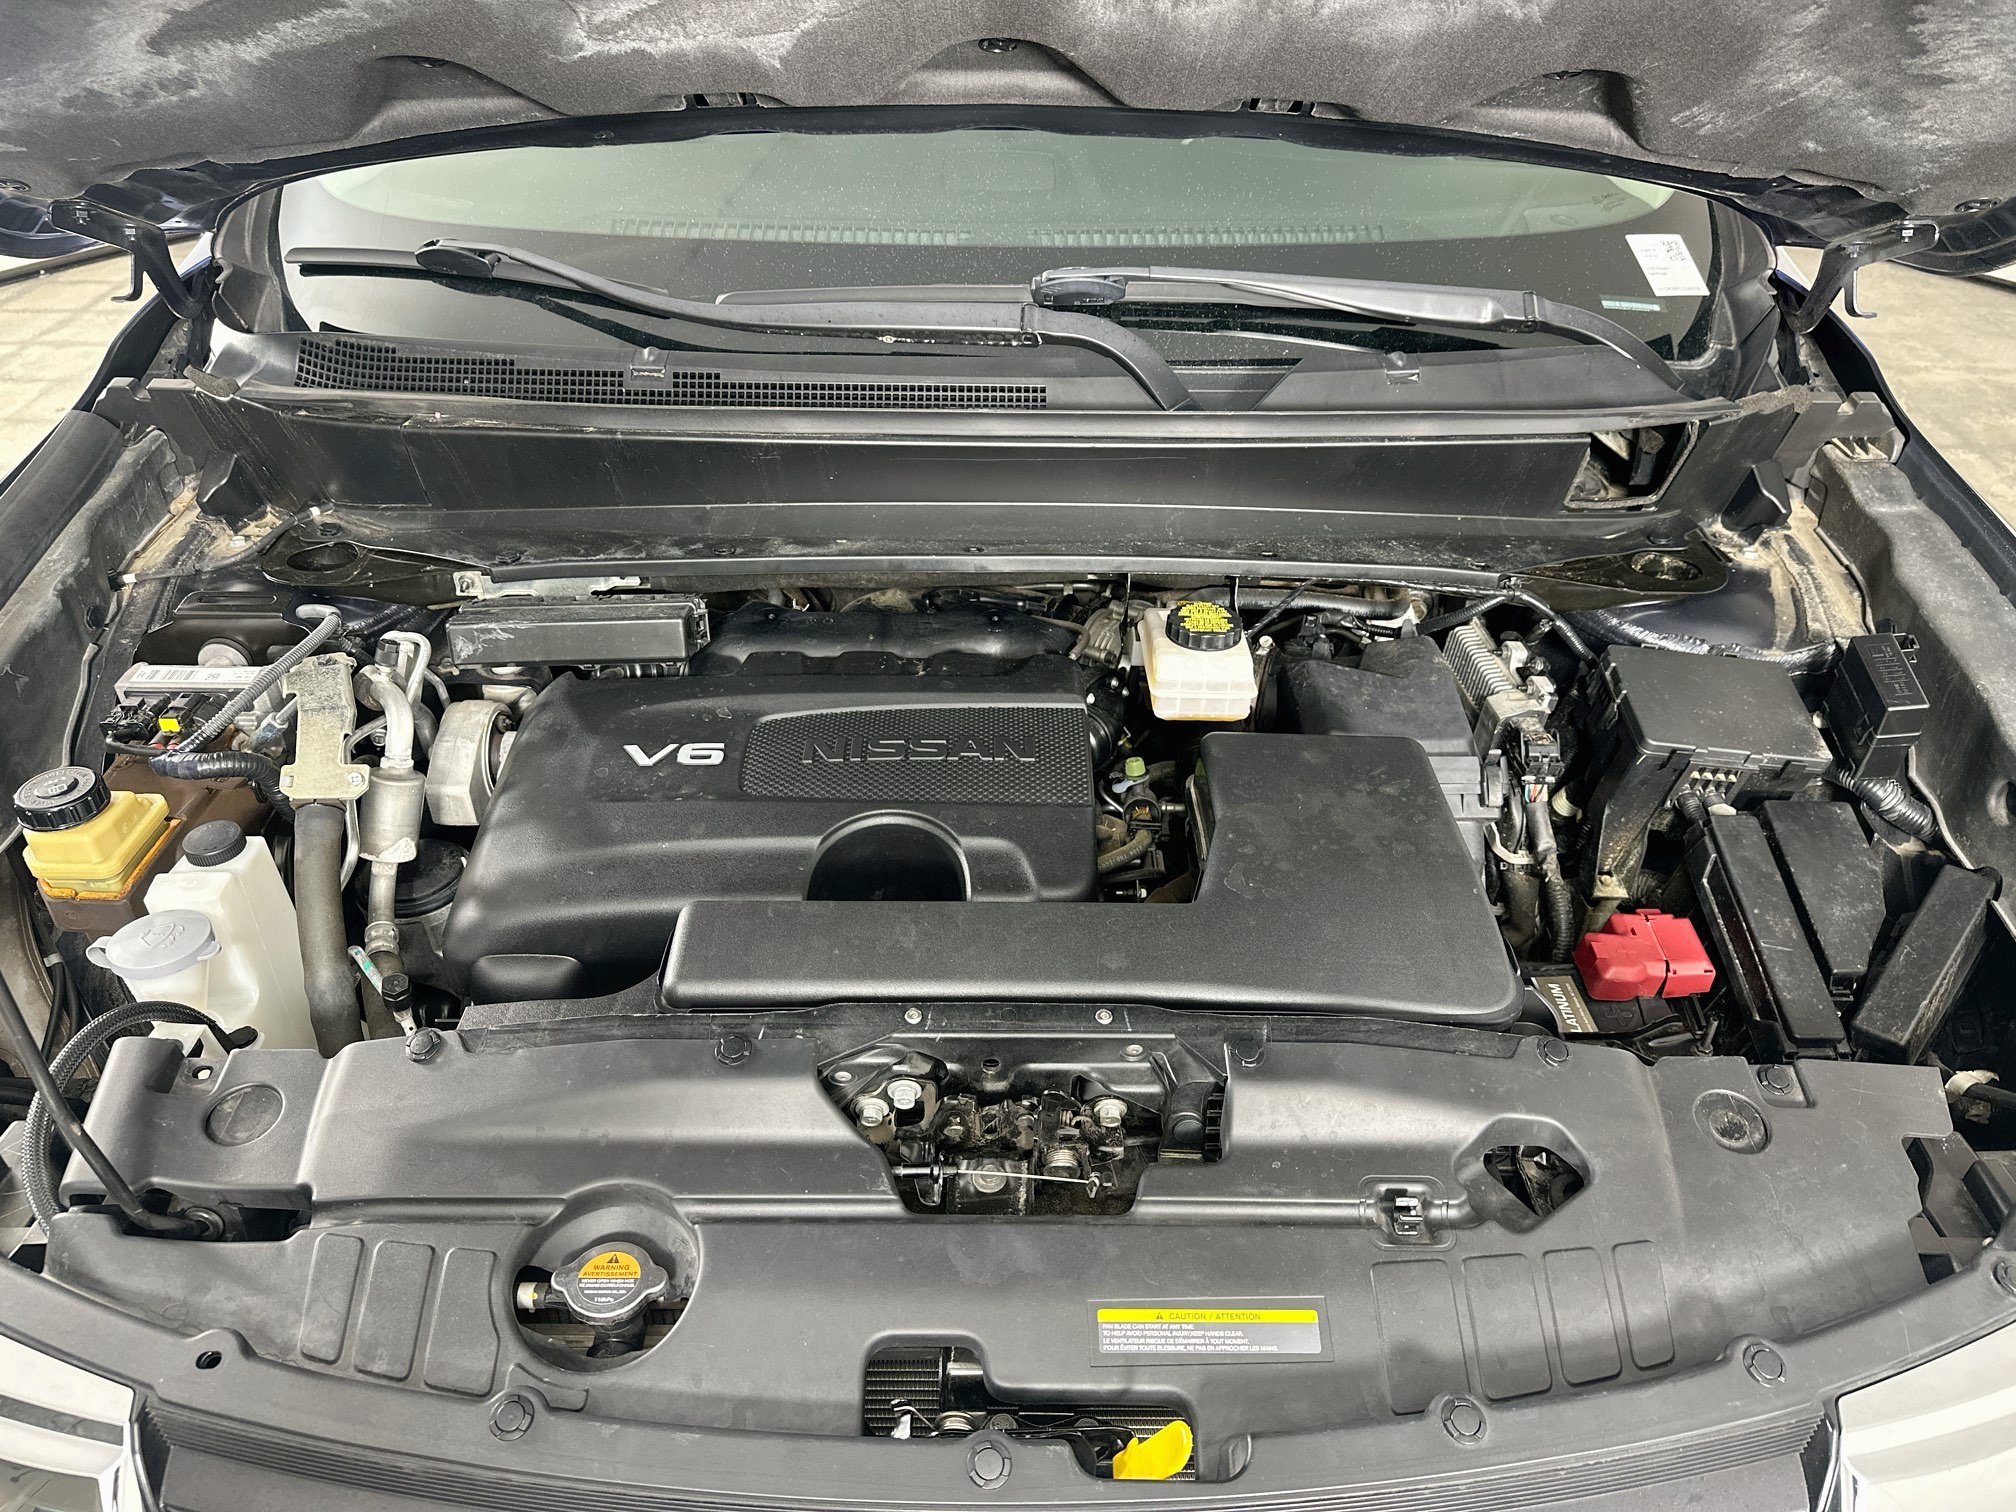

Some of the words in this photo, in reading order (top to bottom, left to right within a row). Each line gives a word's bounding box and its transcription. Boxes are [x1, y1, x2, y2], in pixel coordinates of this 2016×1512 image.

[623, 742, 725, 766] V6
[802, 736, 1036, 764] NISSAN
[1548, 983, 1582, 1032] LATINUM
